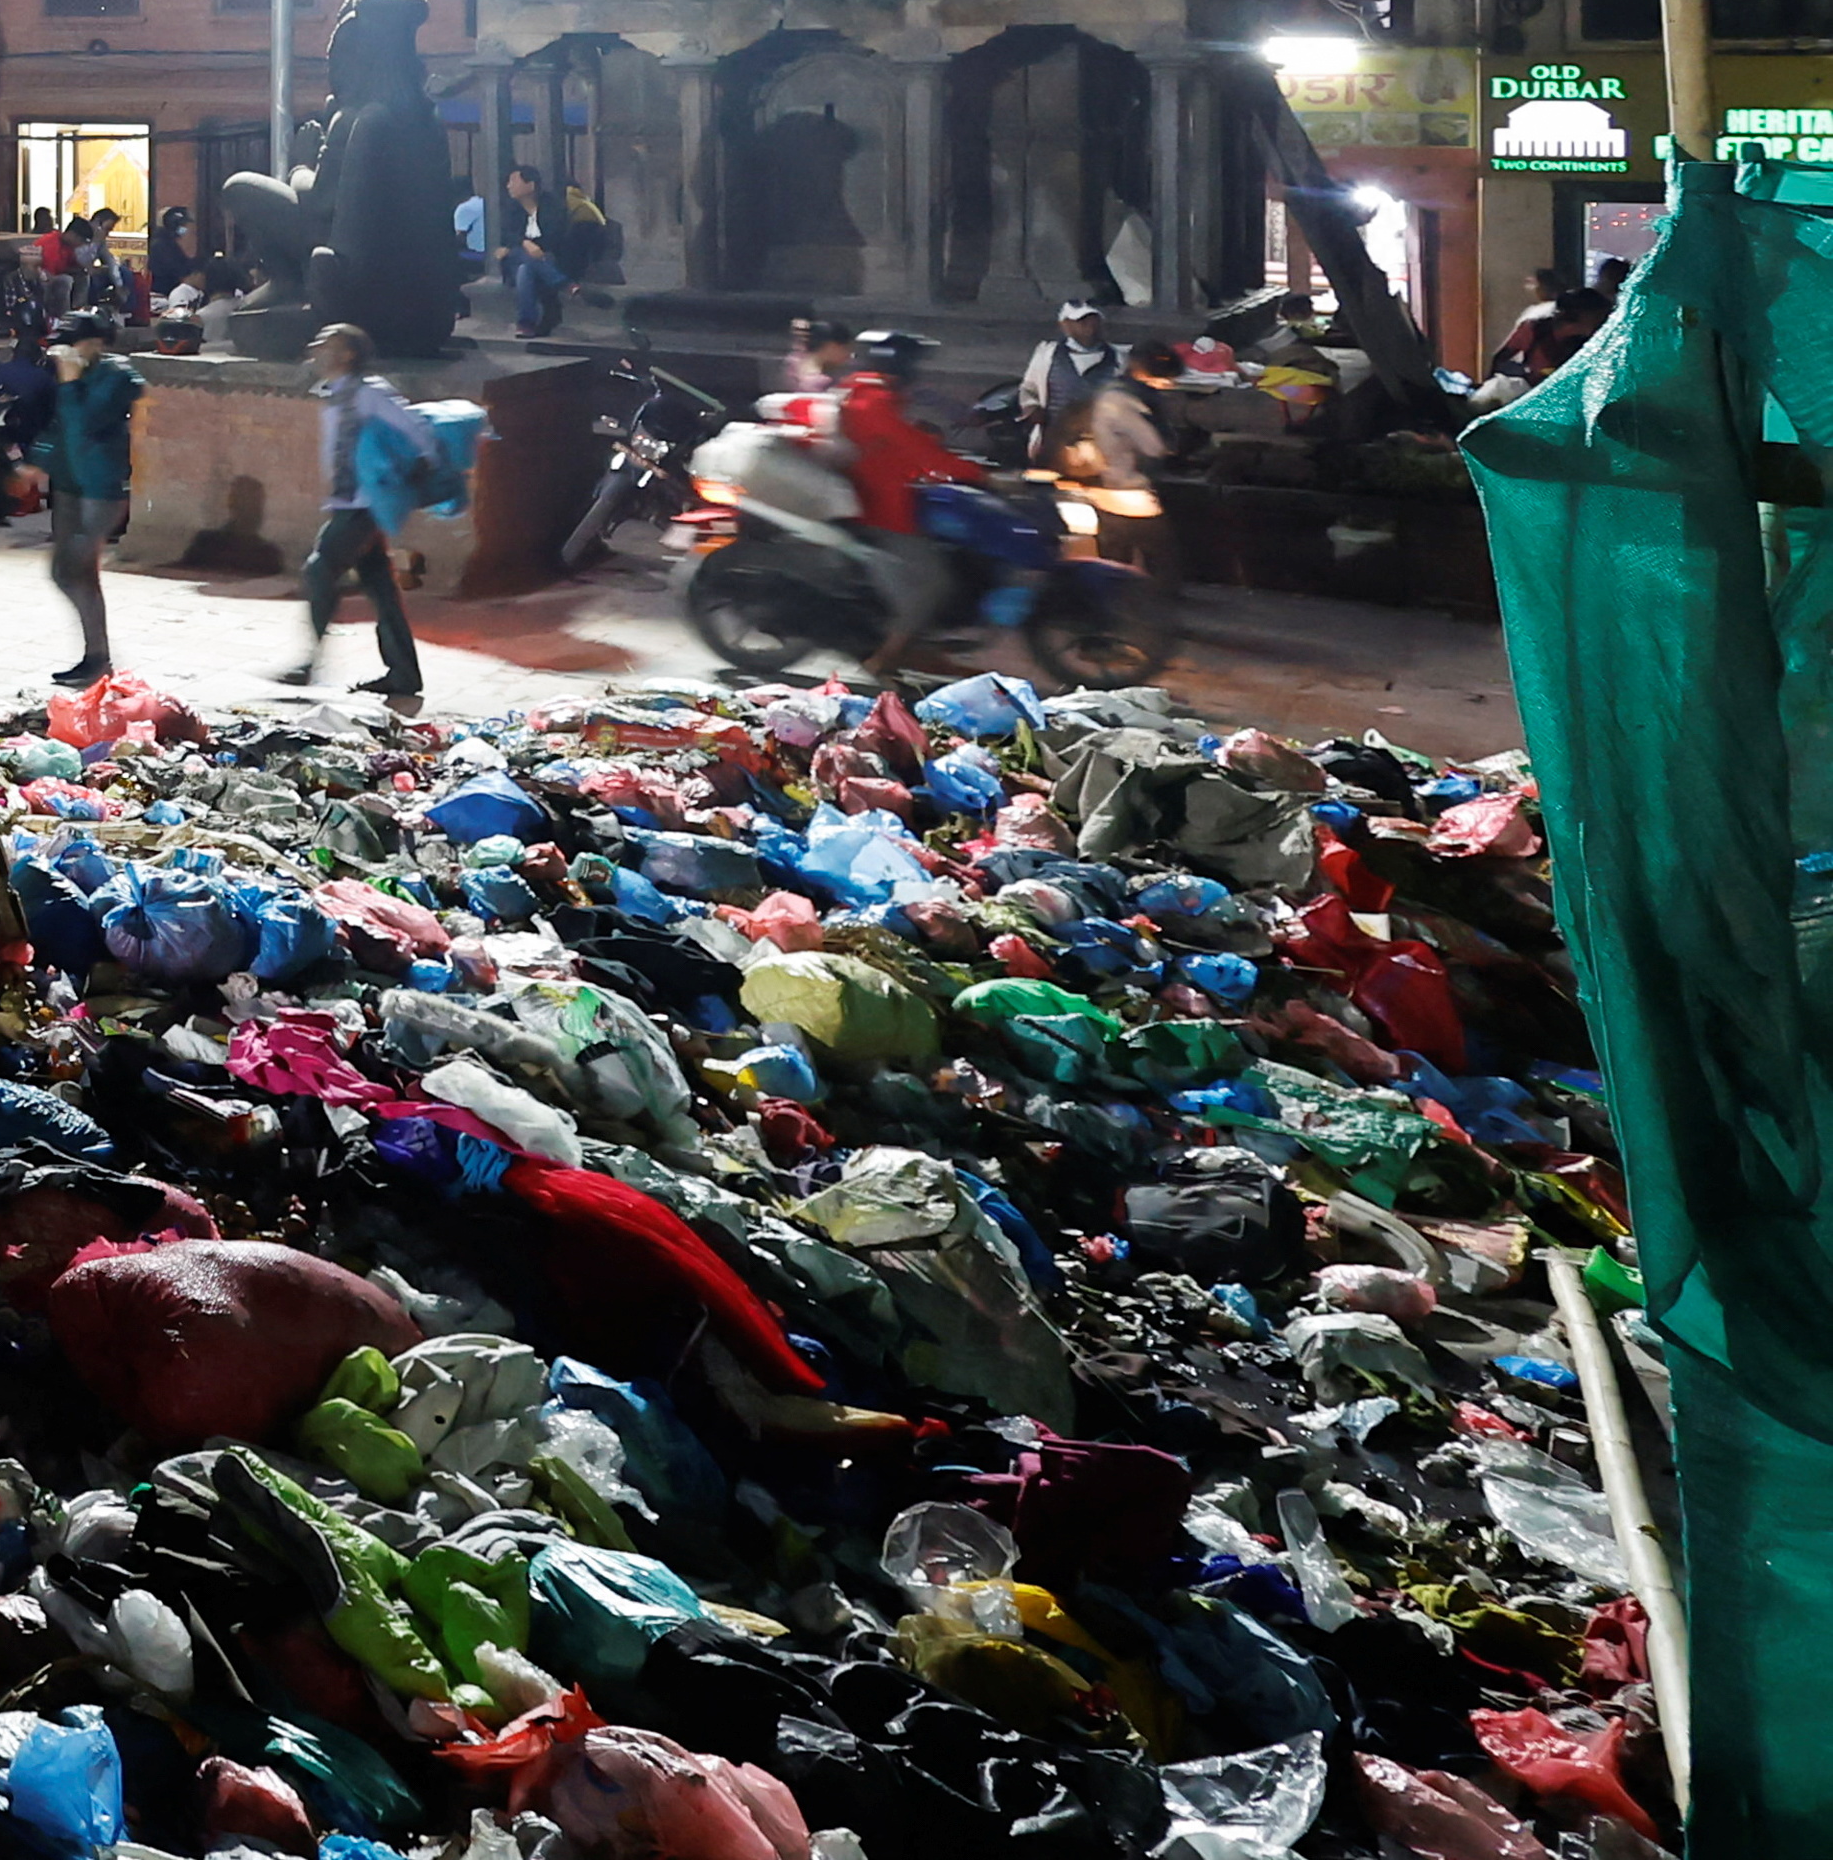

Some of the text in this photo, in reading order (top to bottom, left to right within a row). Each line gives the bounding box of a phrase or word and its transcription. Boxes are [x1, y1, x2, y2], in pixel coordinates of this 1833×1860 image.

[1531, 65, 1581, 79] OLD
[1491, 77, 1626, 99] DURBAR
[1726, 109, 1833, 133] HERITA
[1491, 158, 1627, 173] TWO CONTINENTS
